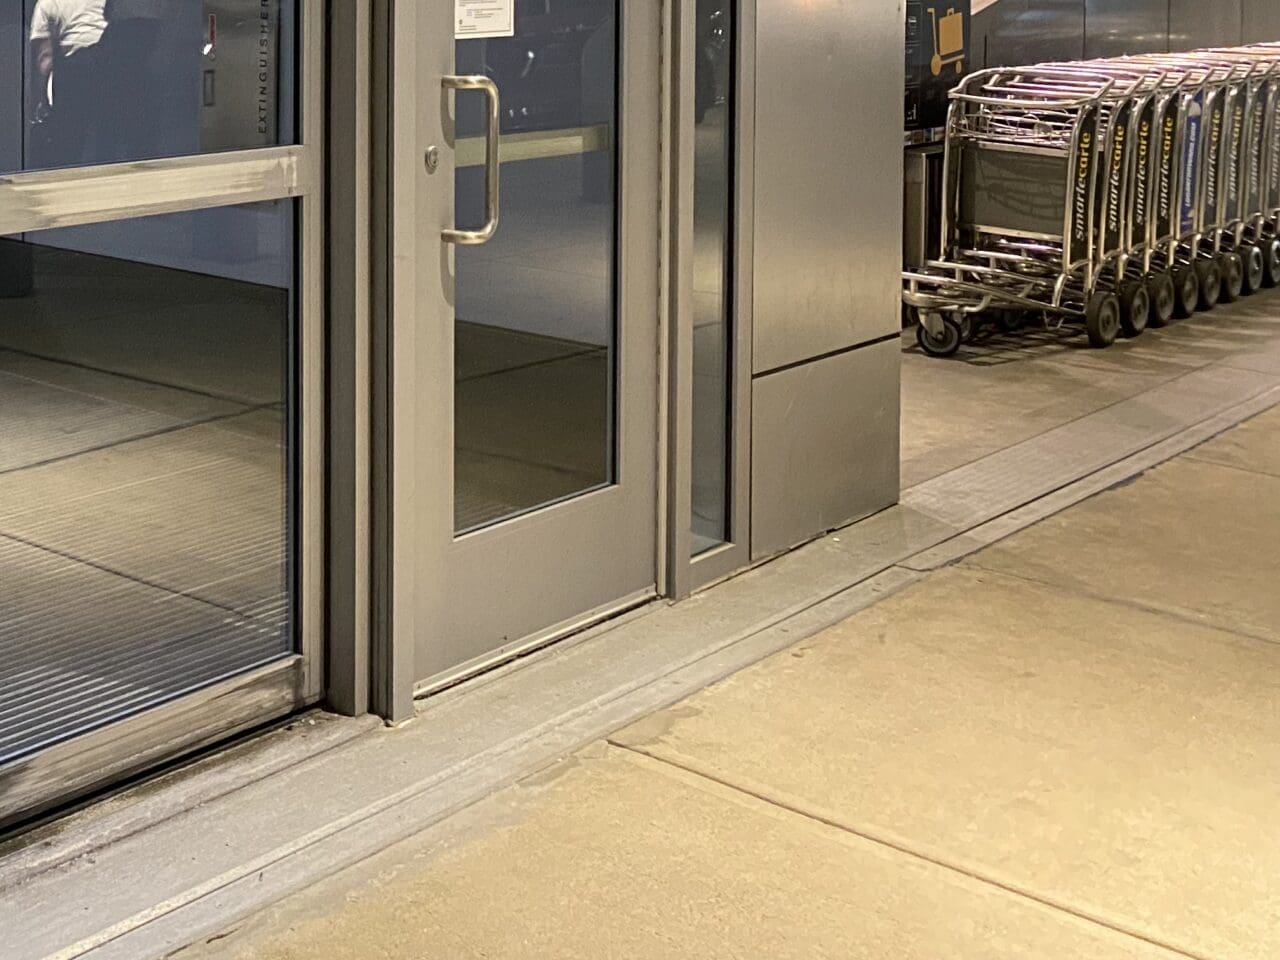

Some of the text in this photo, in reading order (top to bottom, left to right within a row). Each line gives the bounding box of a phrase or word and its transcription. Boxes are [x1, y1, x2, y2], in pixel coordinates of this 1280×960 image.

[1075, 132, 1091, 241] smartecarte
[1108, 125, 1124, 232] smartecarte
[1137, 121, 1149, 225] smartecarte
[1160, 117, 1173, 219] smartecarte
